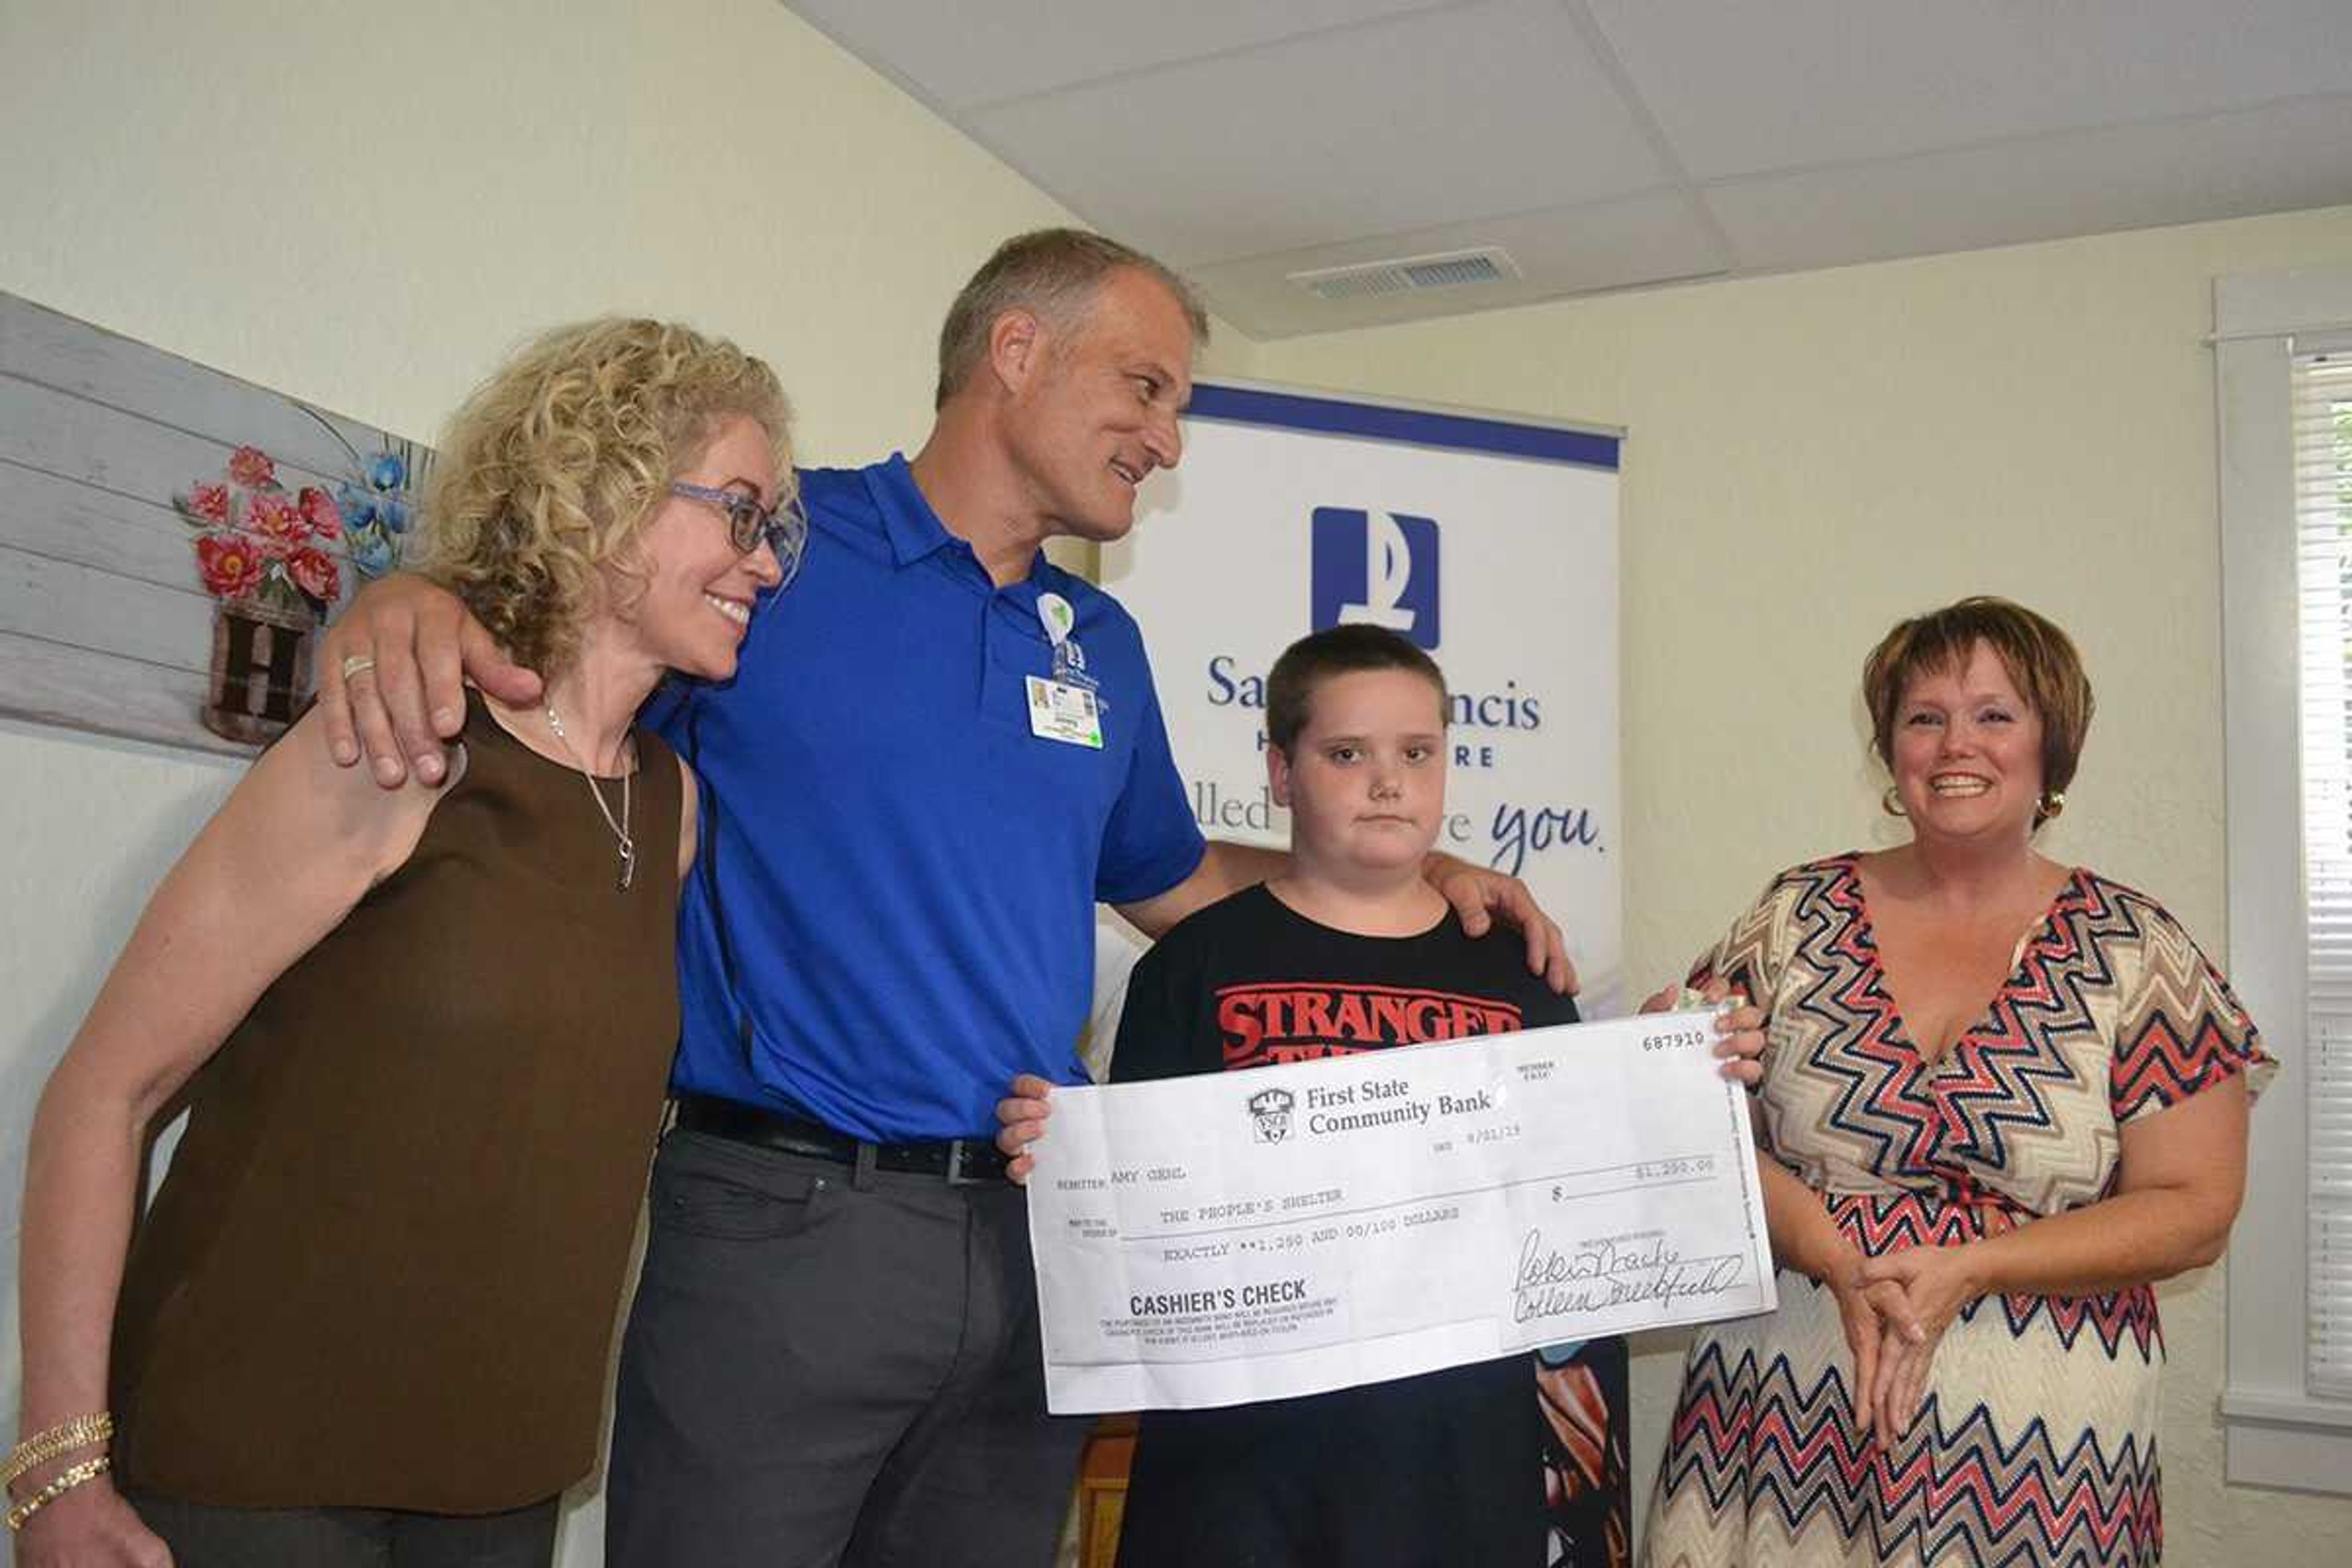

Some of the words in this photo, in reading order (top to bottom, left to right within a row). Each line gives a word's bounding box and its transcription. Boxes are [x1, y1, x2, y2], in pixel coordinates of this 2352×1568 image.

[1444, 681, 1540, 730] ncis
[1196, 782, 1270, 830] lled
[1492, 804, 1604, 876] you.
[1643, 1033, 1705, 1051] 687910
[1307, 1086, 1354, 1110] First
[1362, 1080, 1409, 1101] State
[1310, 1098, 1431, 1134] Community
[1439, 1089, 1491, 1115] Bank
[1111, 1169, 1139, 1184] AMY
[1161, 1208, 1189, 1224] THE
[1199, 1199, 1274, 1219] PEOPLE'S
[1284, 1189, 1346, 1210] SHELTER
[1164, 1243, 1230, 1263] EXACTLY
[1312, 1224, 1340, 1244] AND
[1403, 1207, 1460, 1226] DOLLARS
[1130, 1286, 1236, 1316] CASHIER'S
[1243, 1278, 1306, 1306] CHECK
